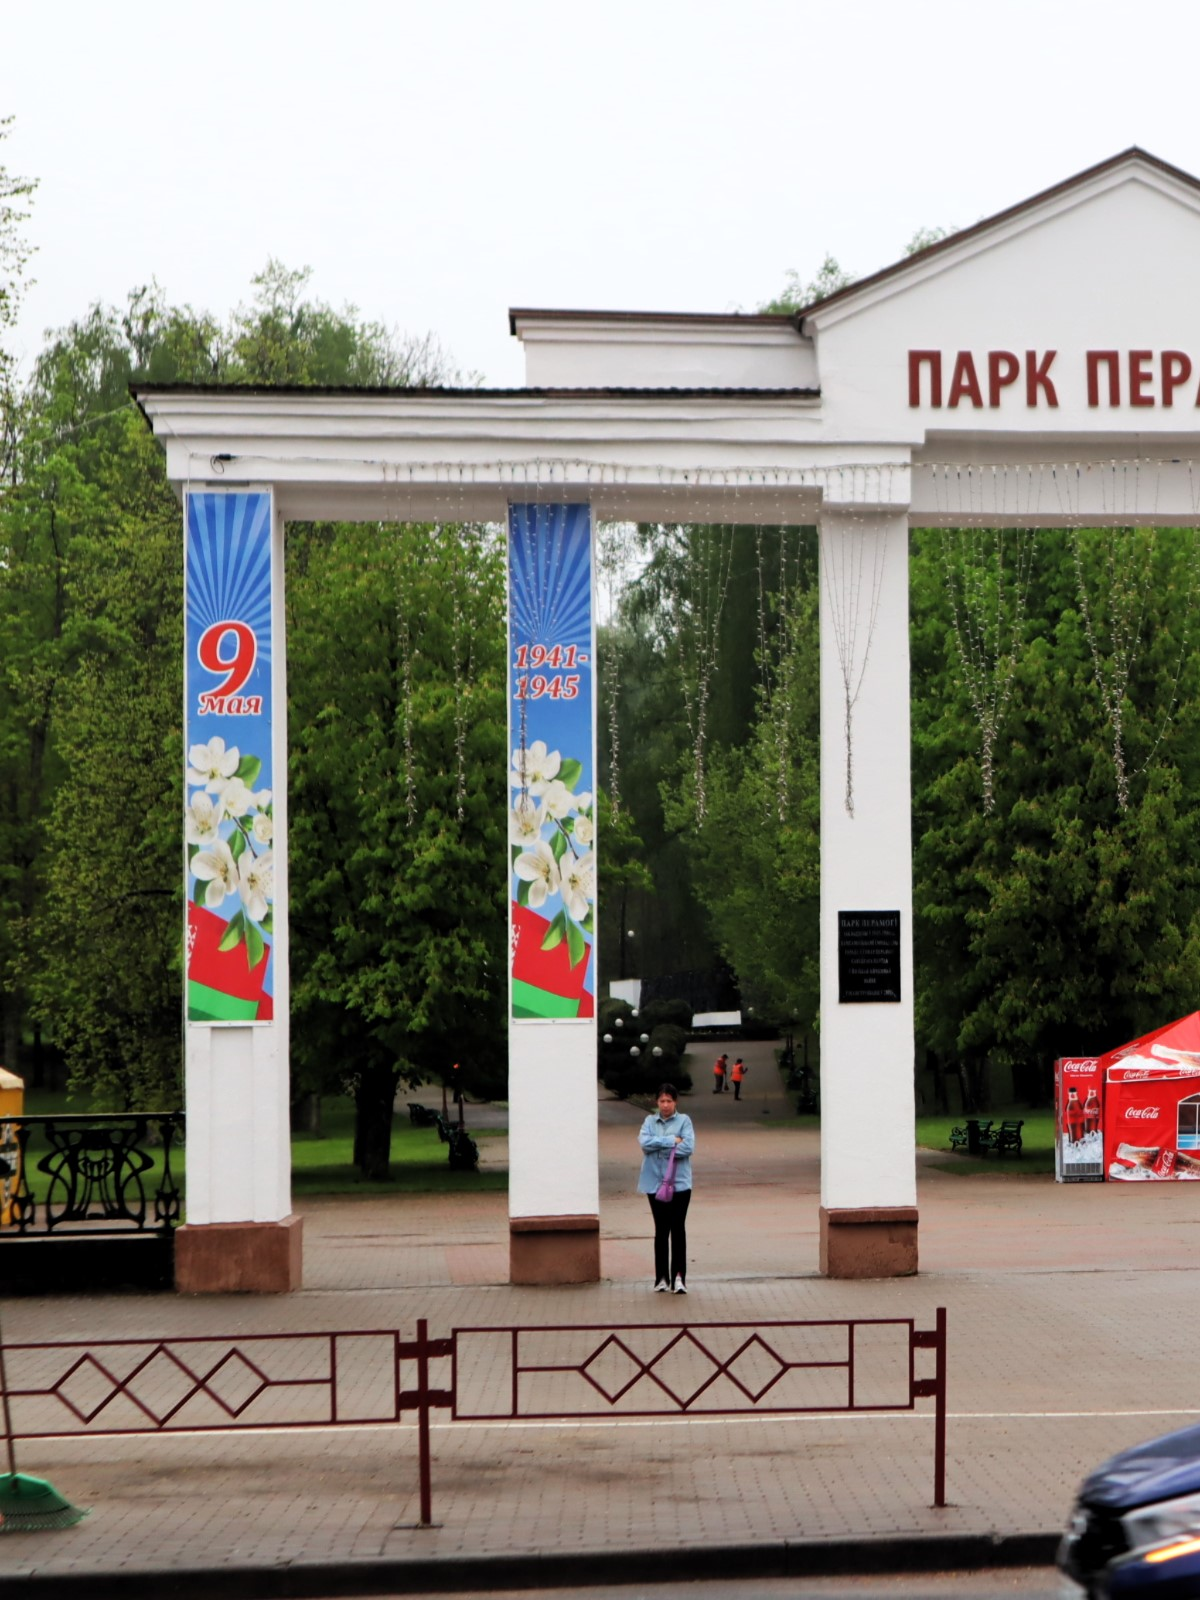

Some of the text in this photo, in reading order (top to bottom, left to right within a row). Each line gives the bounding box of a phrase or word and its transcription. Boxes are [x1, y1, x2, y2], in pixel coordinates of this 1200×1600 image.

[908, 350, 1059, 408] ПАРК
[197, 620, 257, 698] 9
[513, 644, 589, 668] 1941-
[513, 674, 580, 699] 1945
[1063, 1060, 1098, 1073] Coca-Cola
[1125, 1106, 1160, 1119] Coca-Cola
